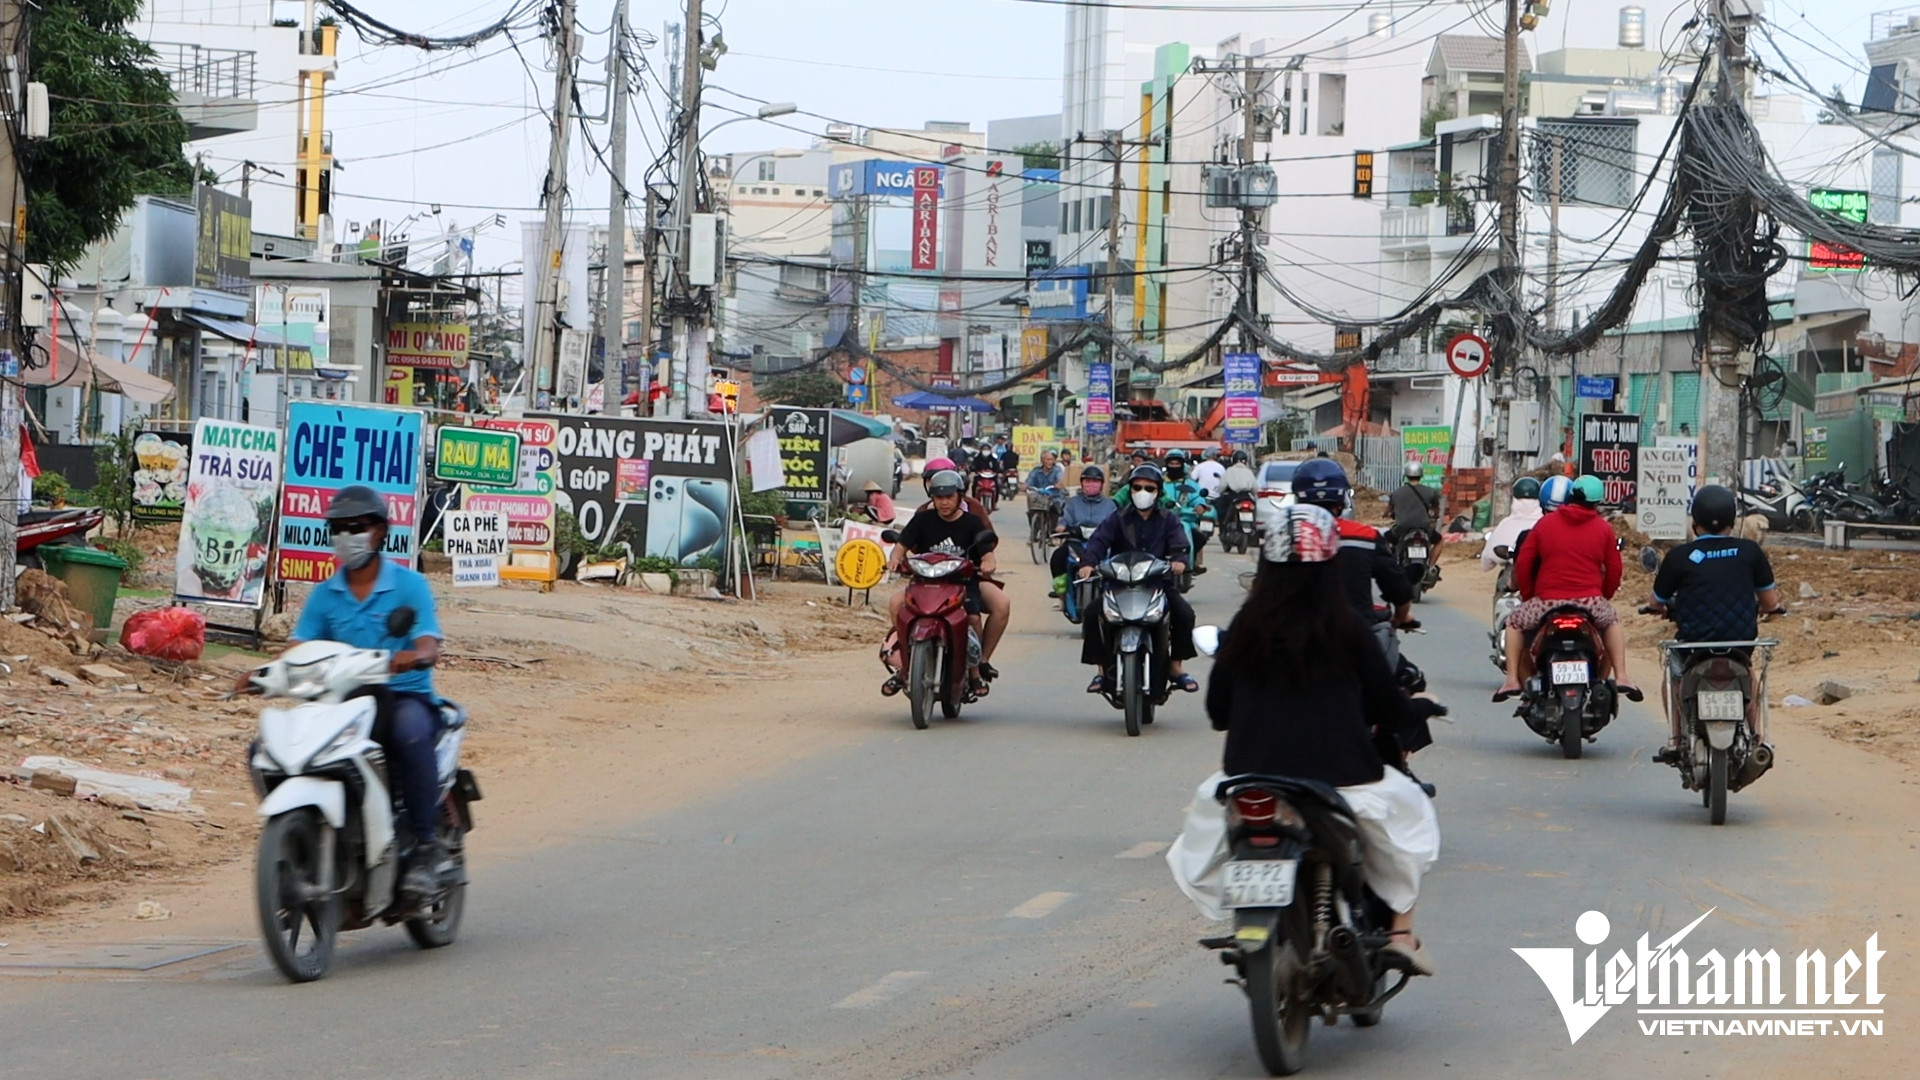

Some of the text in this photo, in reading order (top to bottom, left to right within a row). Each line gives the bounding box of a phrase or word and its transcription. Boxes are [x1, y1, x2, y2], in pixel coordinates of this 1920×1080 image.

[919, 192, 931, 264] AGRIBANK
[986, 183, 999, 267] AGRIBANK
[202, 425, 276, 452] MATCHA
[1602, 417, 1618, 442] TÓC
[1619, 422, 1638, 443] NAM
[293, 410, 413, 486] CHÈ THÁI
[441, 439, 479, 467] RAU
[482, 437, 511, 471] MÁ
[643, 428, 720, 464] PHÁT
[1642, 450, 1685, 462] AN GIA
[199, 452, 273, 482] TRÀ SỮA
[1592, 444, 1630, 473] TRÚC
[569, 466, 610, 491] GÓP
[1644, 470, 1682, 486] Nệm
[287, 490, 322, 514] TRÀ
[531, 503, 548, 517] LAN
[1640, 497, 1684, 505] FUJIKA
[453, 513, 498, 532] CÀ PHÊ
[284, 525, 311, 546] MILO
[448, 539, 472, 553] PHA
[1706, 548, 1738, 559] SHBET
[281, 556, 336, 580] SINH TỐ
